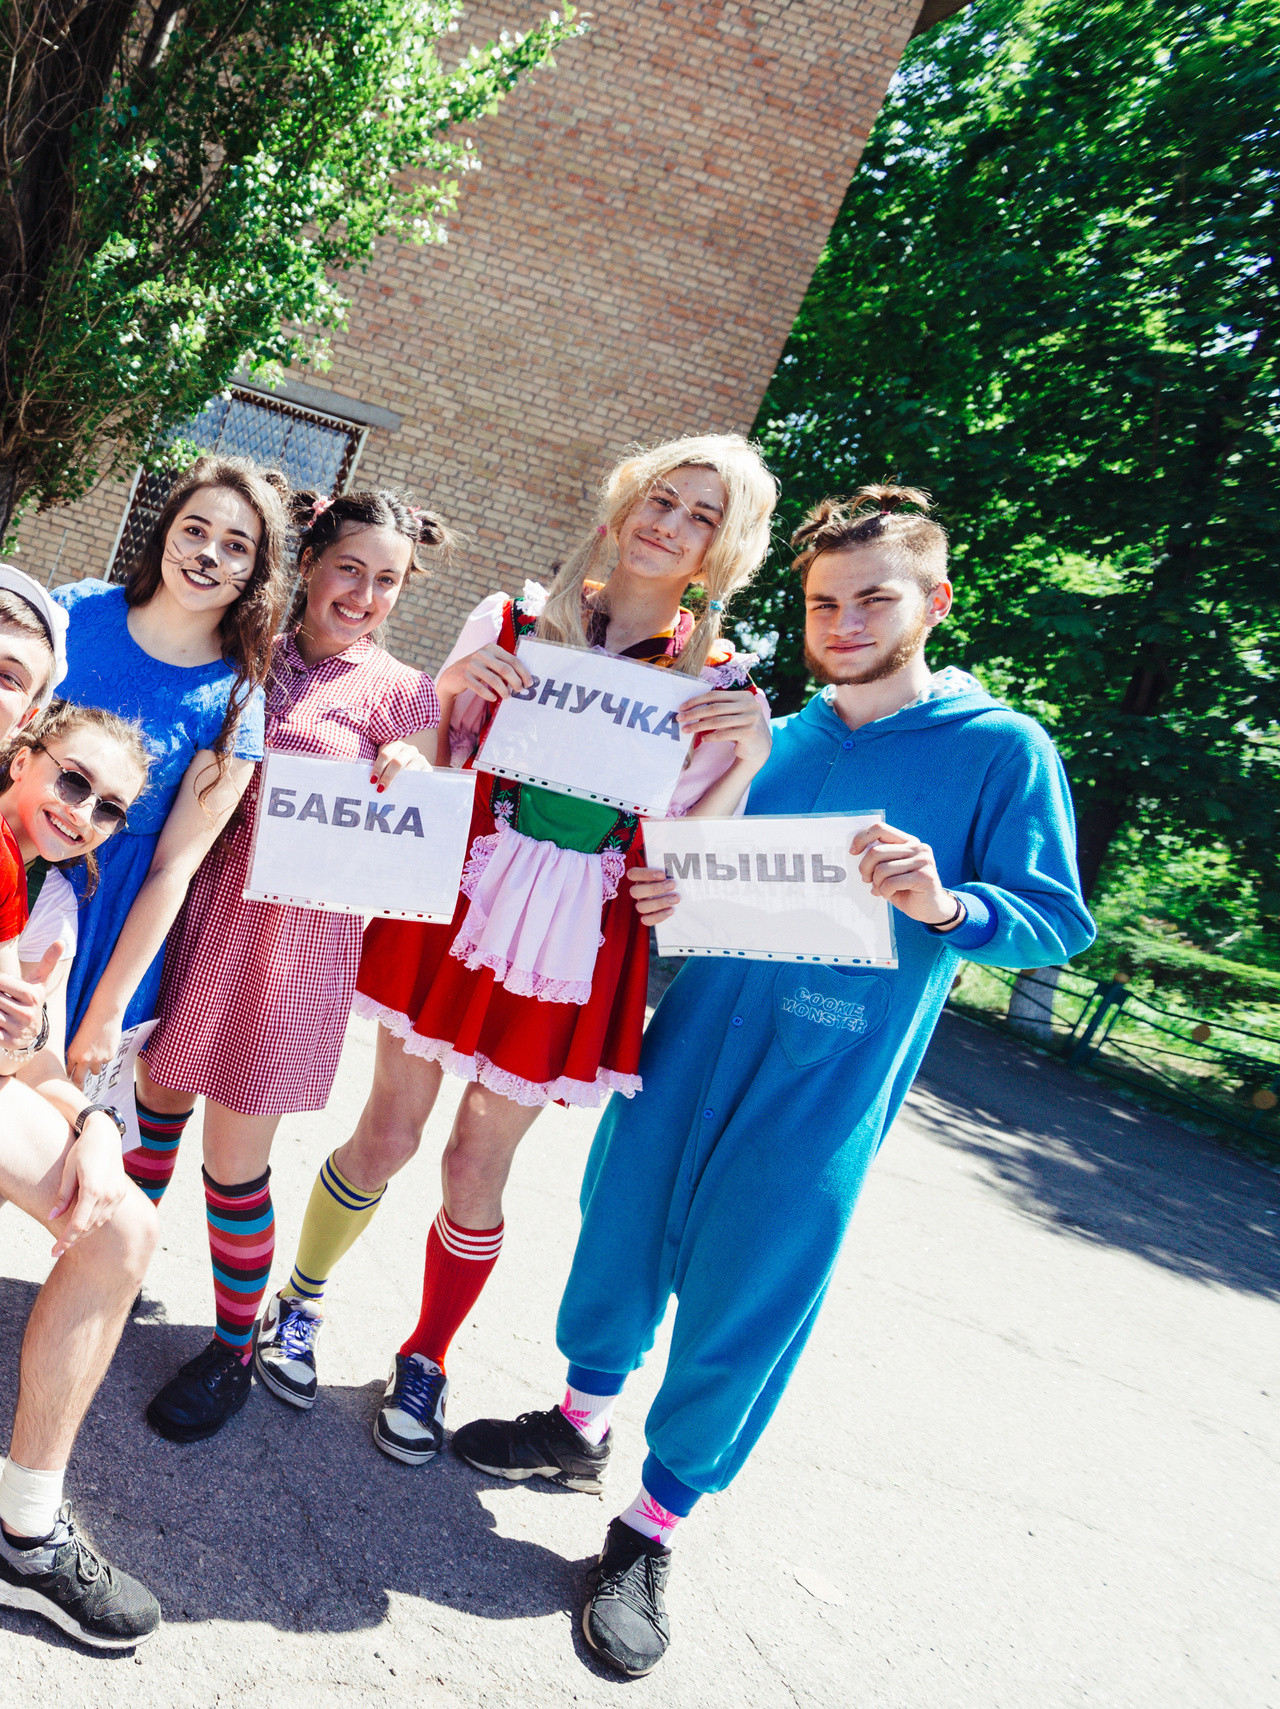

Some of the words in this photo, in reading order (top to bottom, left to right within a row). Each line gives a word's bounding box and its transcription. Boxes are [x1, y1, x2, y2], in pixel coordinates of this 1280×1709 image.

[510, 674, 681, 742] ВНУЧКА
[267, 786, 425, 839] БАБКА
[663, 852, 847, 884] МЫШЬ
[781, 997, 868, 1035] MONSTER
[794, 987, 865, 1019] COOKIE
